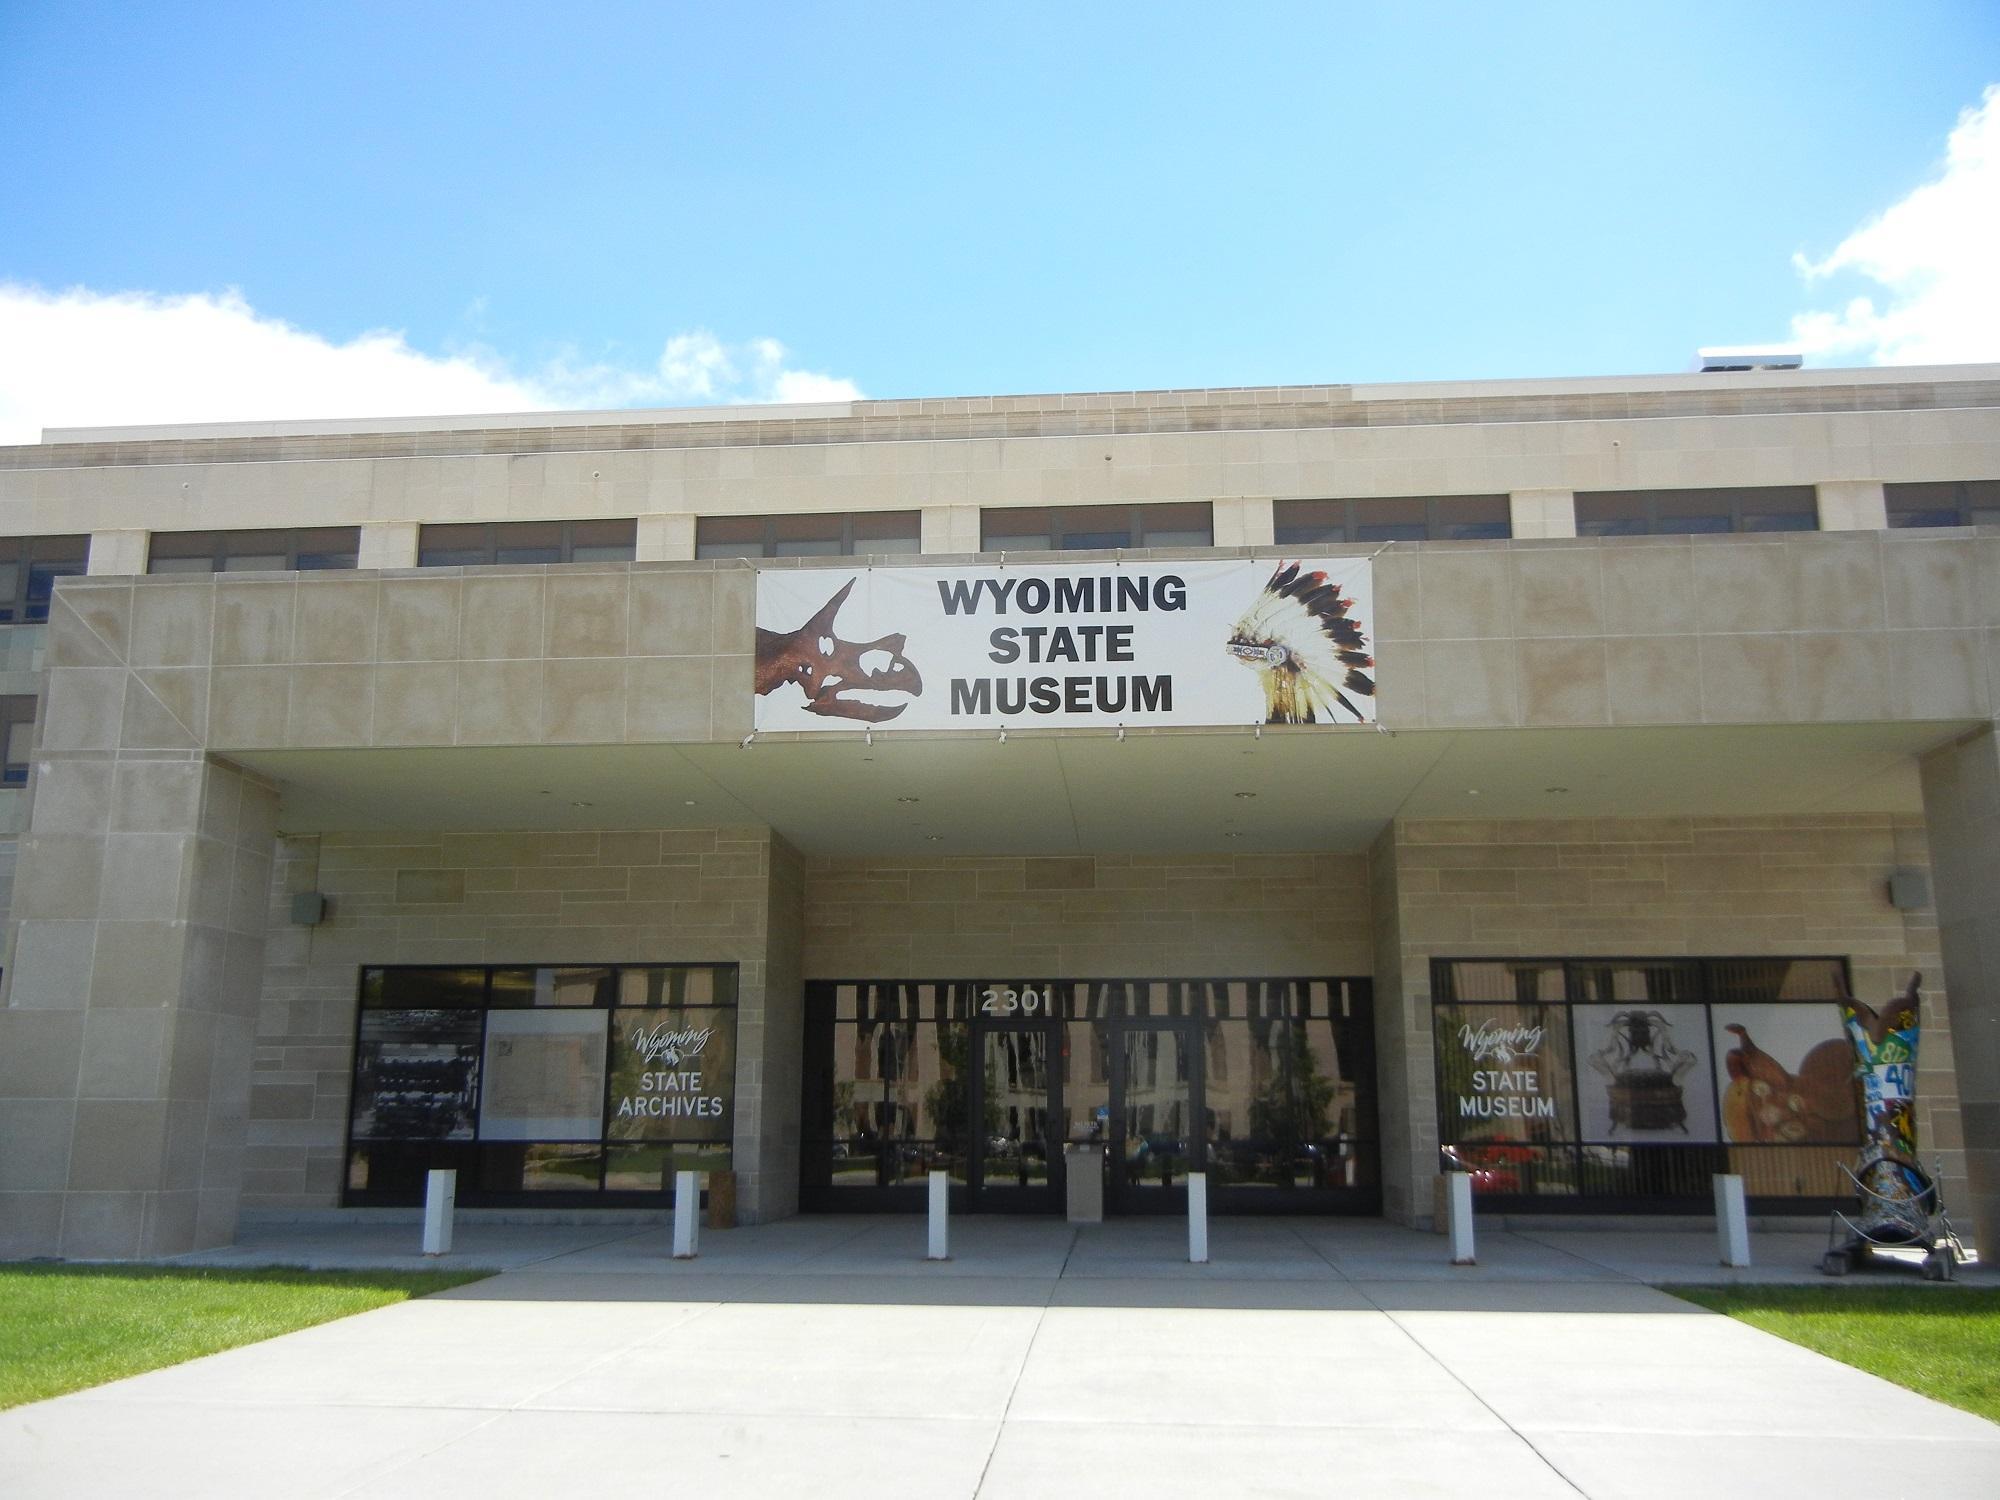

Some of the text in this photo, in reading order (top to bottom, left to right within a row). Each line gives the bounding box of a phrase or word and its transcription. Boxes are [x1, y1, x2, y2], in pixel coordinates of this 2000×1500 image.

[937, 575, 1187, 615] WYOMING
[988, 625, 1134, 664] STATE
[951, 675, 1173, 715] MUSEUM
[981, 990, 1053, 1011] 2301
[632, 1020, 716, 1064] Wyoming
[1458, 1018, 1547, 1061] Wyoming
[641, 1072, 702, 1092] STATE
[1473, 1070, 1538, 1092] STATE
[618, 1096, 723, 1116] ARCHIVES
[1460, 1096, 1553, 1118] MUSEUM
